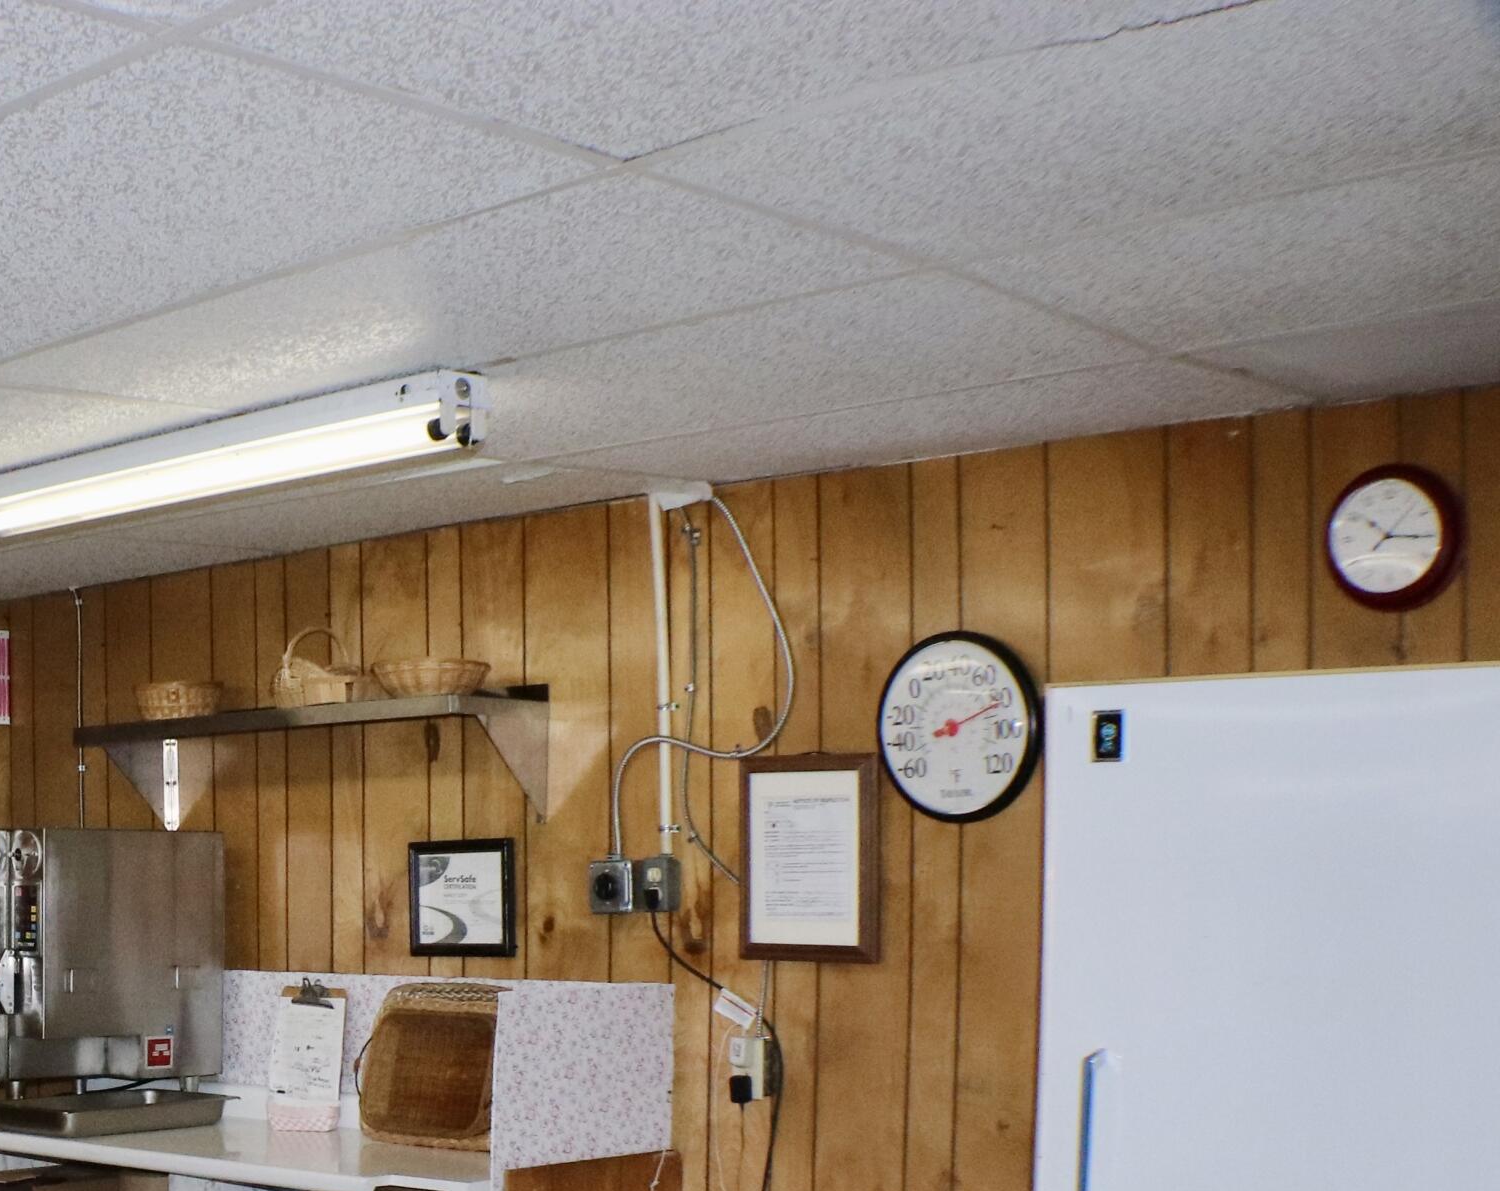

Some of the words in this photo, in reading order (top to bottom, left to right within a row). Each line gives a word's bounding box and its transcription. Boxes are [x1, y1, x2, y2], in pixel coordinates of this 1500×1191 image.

[972, 664, 997, 687] 60
[908, 678, 921, 699] 0
[887, 705, 915, 726] -20
[993, 718, 1022, 740] 100
[898, 757, 927, 779] -60
[984, 751, 1013, 775] 120
[444, 875, 476, 883] ServSafe
